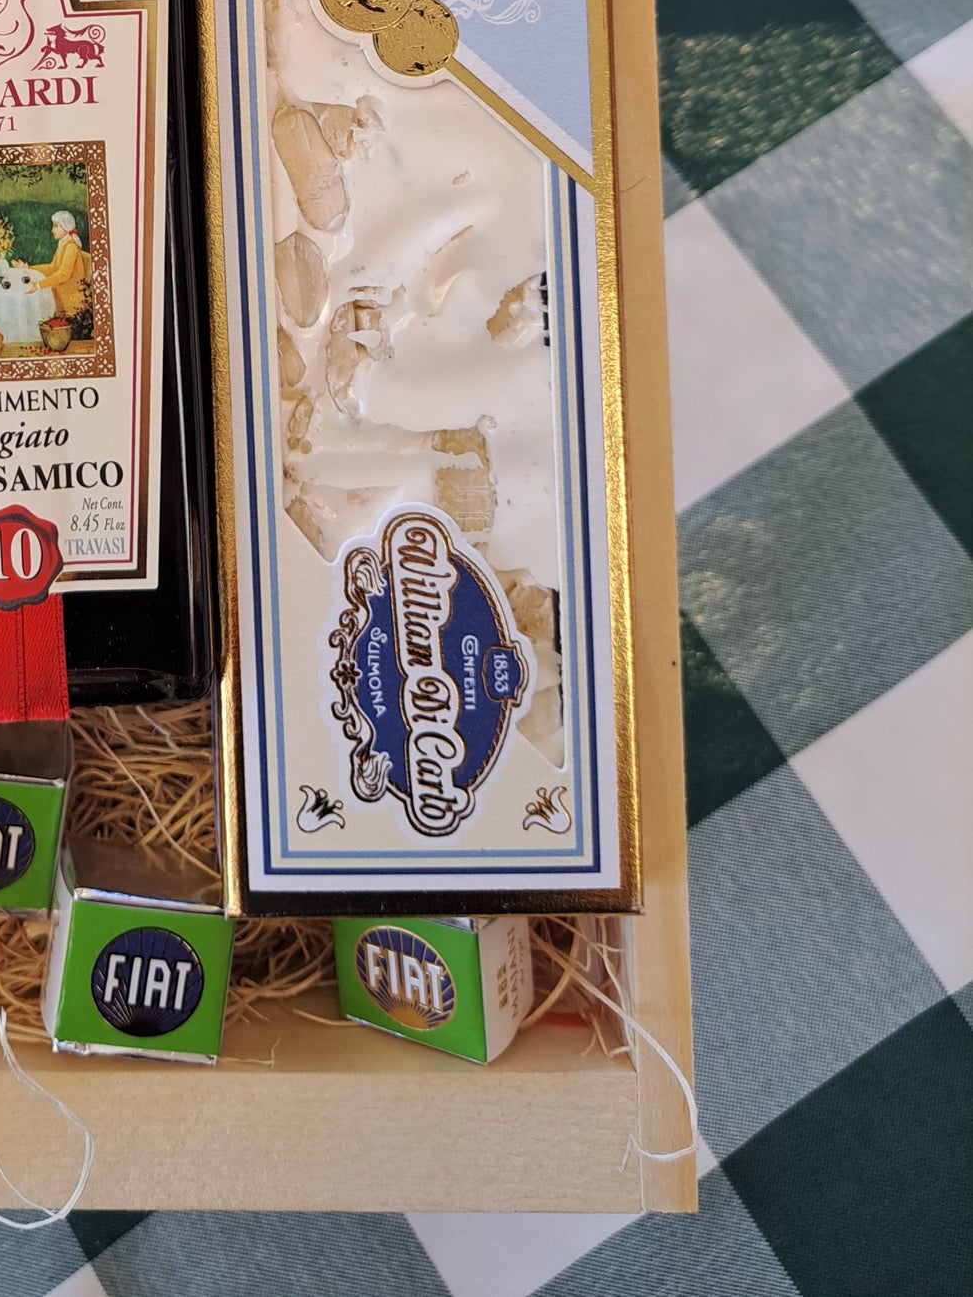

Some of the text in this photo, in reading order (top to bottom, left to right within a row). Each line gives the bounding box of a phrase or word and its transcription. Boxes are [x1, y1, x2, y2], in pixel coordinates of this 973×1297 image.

[69, 513, 100, 533] 8.45
[81, 496, 124, 512] Net Cont.
[64, 538, 126, 557] TRAVASI
[398, 526, 451, 667] William
[366, 626, 389, 718] SULMONA
[460, 633, 478, 711] CONFETTI
[492, 651, 510, 694] 1833
[412, 730, 461, 821] Carlo
[103, 954, 193, 1009] FIAT
[362, 942, 444, 1014] FIAT
